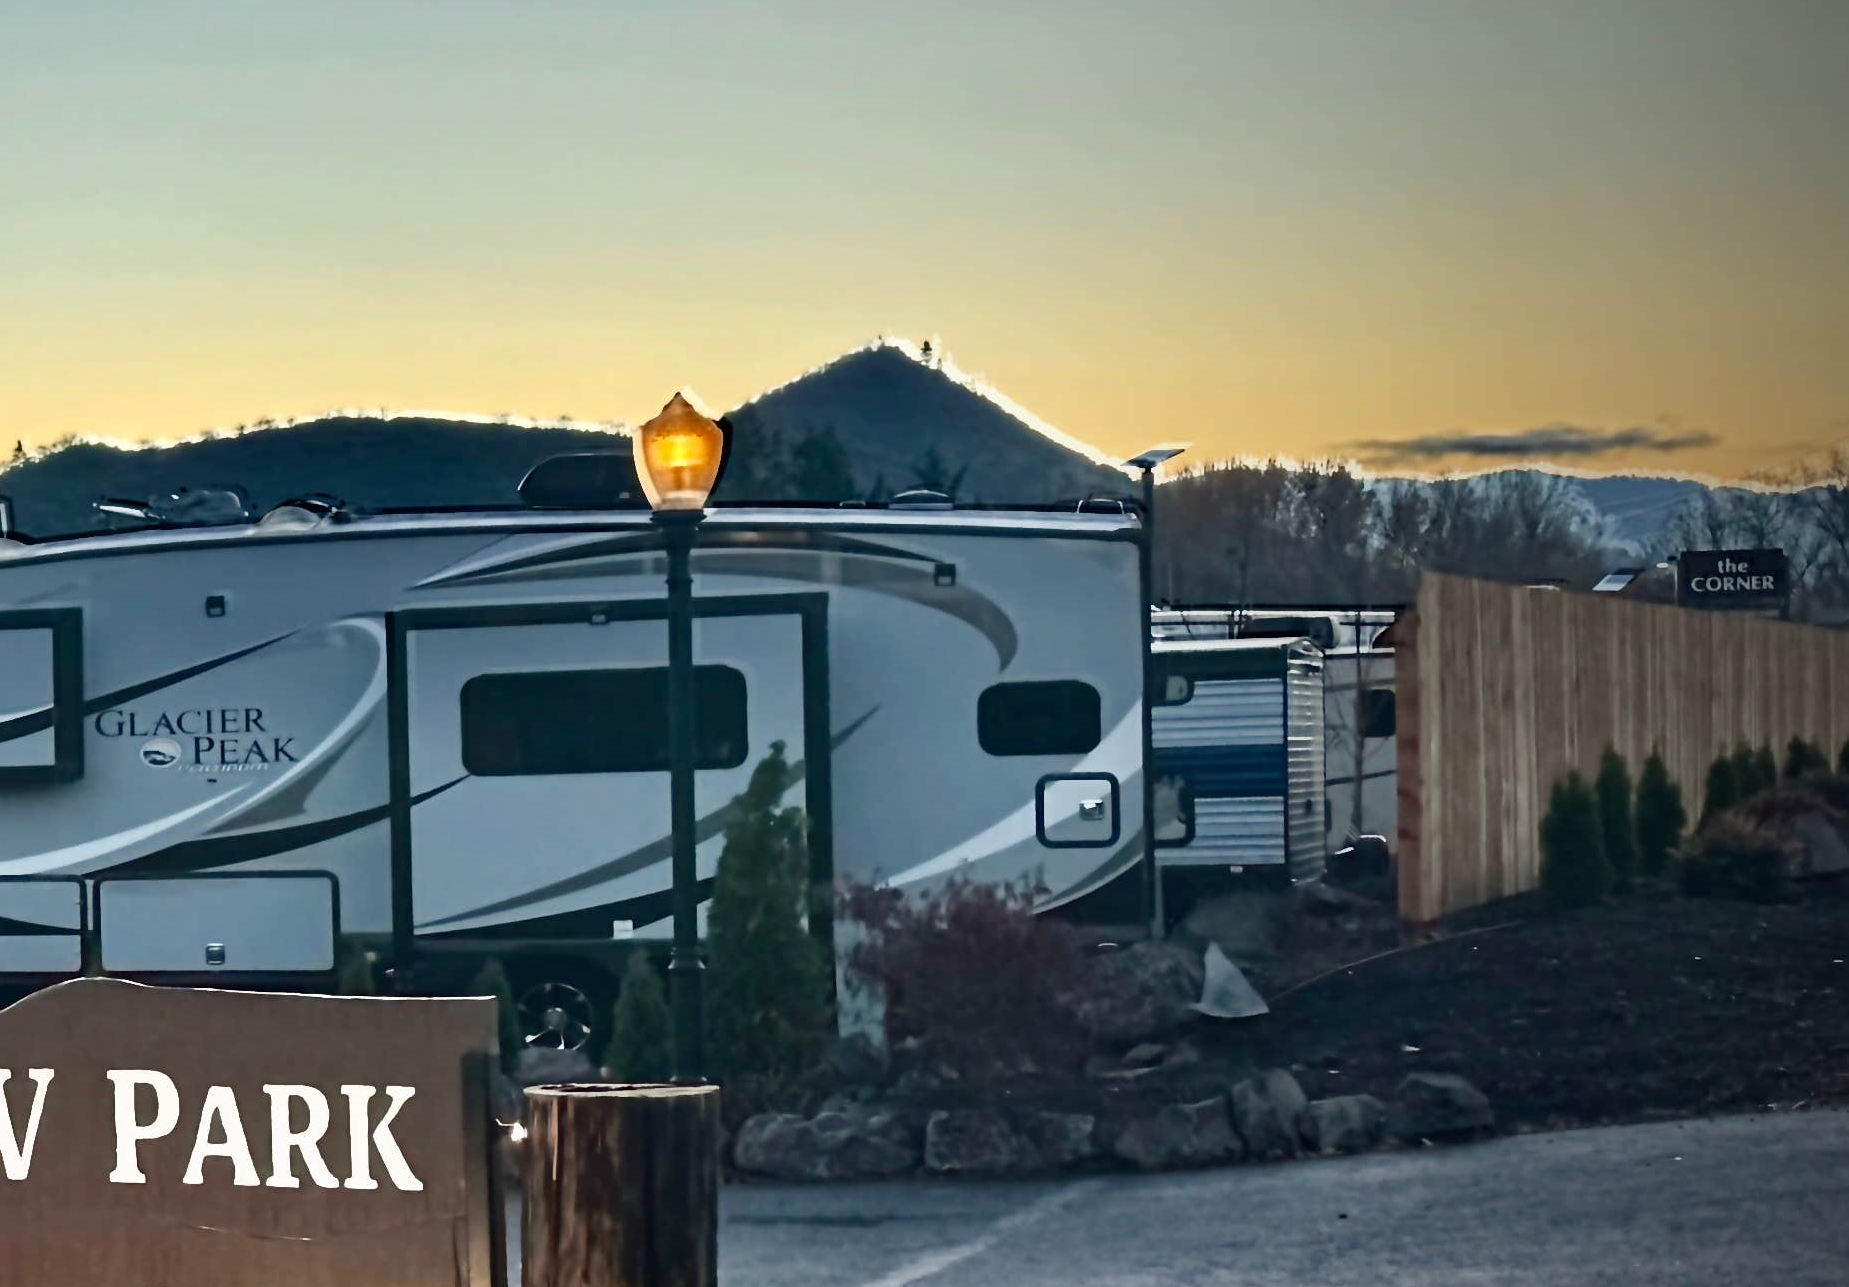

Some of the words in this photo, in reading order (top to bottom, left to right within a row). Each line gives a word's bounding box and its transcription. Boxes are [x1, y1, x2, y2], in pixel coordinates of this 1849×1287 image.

[1717, 557, 1749, 574] the
[1690, 575, 1775, 592] CORNER
[93, 707, 267, 738] GLACIER
[193, 735, 300, 765] PEAK
[106, 1069, 425, 1193] PARK
